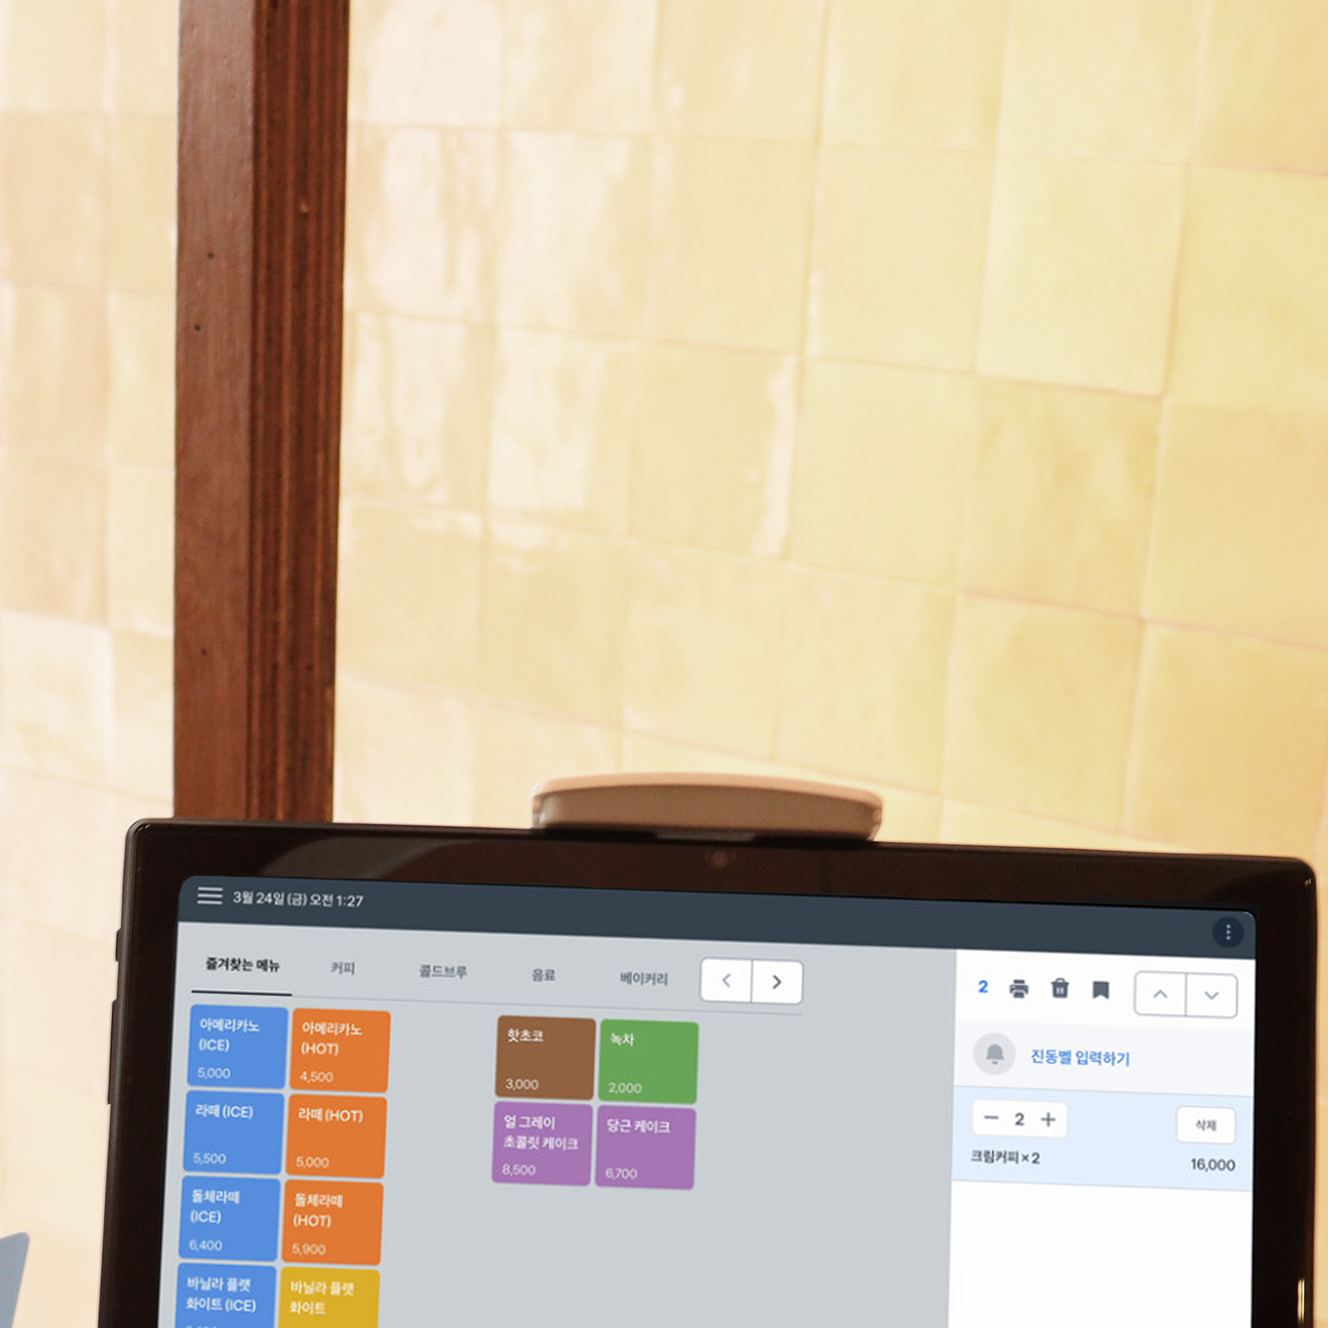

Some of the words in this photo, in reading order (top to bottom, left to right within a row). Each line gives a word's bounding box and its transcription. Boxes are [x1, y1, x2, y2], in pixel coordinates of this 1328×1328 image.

[233, 891, 253, 904] 3월
[256, 892, 284, 905] 24일
[287, 893, 307, 906] (금)
[310, 894, 333, 907] 오전
[337, 895, 363, 907] 1:27
[206, 957, 253, 971] 즐겨찾는
[256, 959, 280, 972] 메뉴
[331, 962, 355, 975] 커피
[420, 964, 467, 979] 콜드브루
[532, 968, 555, 982] 음료
[620, 972, 668, 986] 베이커리
[979, 980, 988, 993] 2
[200, 1018, 260, 1033] 아메리카노
[302, 1022, 362, 1036] 아메리카노
[508, 1028, 543, 1042] 핫초코
[611, 1033, 634, 1046] 녹차
[199, 1038, 230, 1052] (ICE)
[302, 1042, 339, 1056] (HOT)
[1032, 1049, 1071, 1065] 진동벨
[1076, 1051, 1130, 1067] 입력하기
[198, 1067, 231, 1079] 5,000
[300, 1071, 334, 1083] 4,500
[506, 1078, 539, 1090] 3,000
[609, 1082, 642, 1094] 2,000
[196, 1104, 220, 1117] 라떼
[223, 1105, 253, 1119] (ICE)
[299, 1108, 323, 1121] 라떼
[325, 1109, 363, 1123] (HOT)
[504, 1115, 516, 1129] 얼
[519, 1116, 555, 1130] 그레이
[1015, 1112, 1024, 1126] 2
[1196, 1120, 1217, 1131] 삭제
[607, 1119, 631, 1133] 당근
[634, 1120, 670, 1134] 케이크
[543, 1137, 578, 1150] 케이크
[194, 1153, 227, 1164] 5,500
[296, 1156, 330, 1169] 5,000
[1191, 1158, 1236, 1172] 16,000
[502, 1163, 536, 1176] 8,500
[605, 1168, 638, 1180] 6,700
[192, 1189, 240, 1204] 돌체라떼
[295, 1193, 343, 1208] 돌체라떼
[191, 1210, 221, 1224] (ICE)
[294, 1213, 332, 1228] (HOT)
[189, 1240, 223, 1251] 6,400
[292, 1243, 326, 1256] 5,900
[187, 1277, 224, 1291] 바닐라
[227, 1278, 251, 1292] 플랫
[291, 1281, 327, 1295] 바닐라
[330, 1282, 354, 1296] 플랫
[187, 1297, 222, 1311] 화이트
[225, 1299, 256, 1313] (ICE)
[290, 1301, 326, 1315] 화이트
